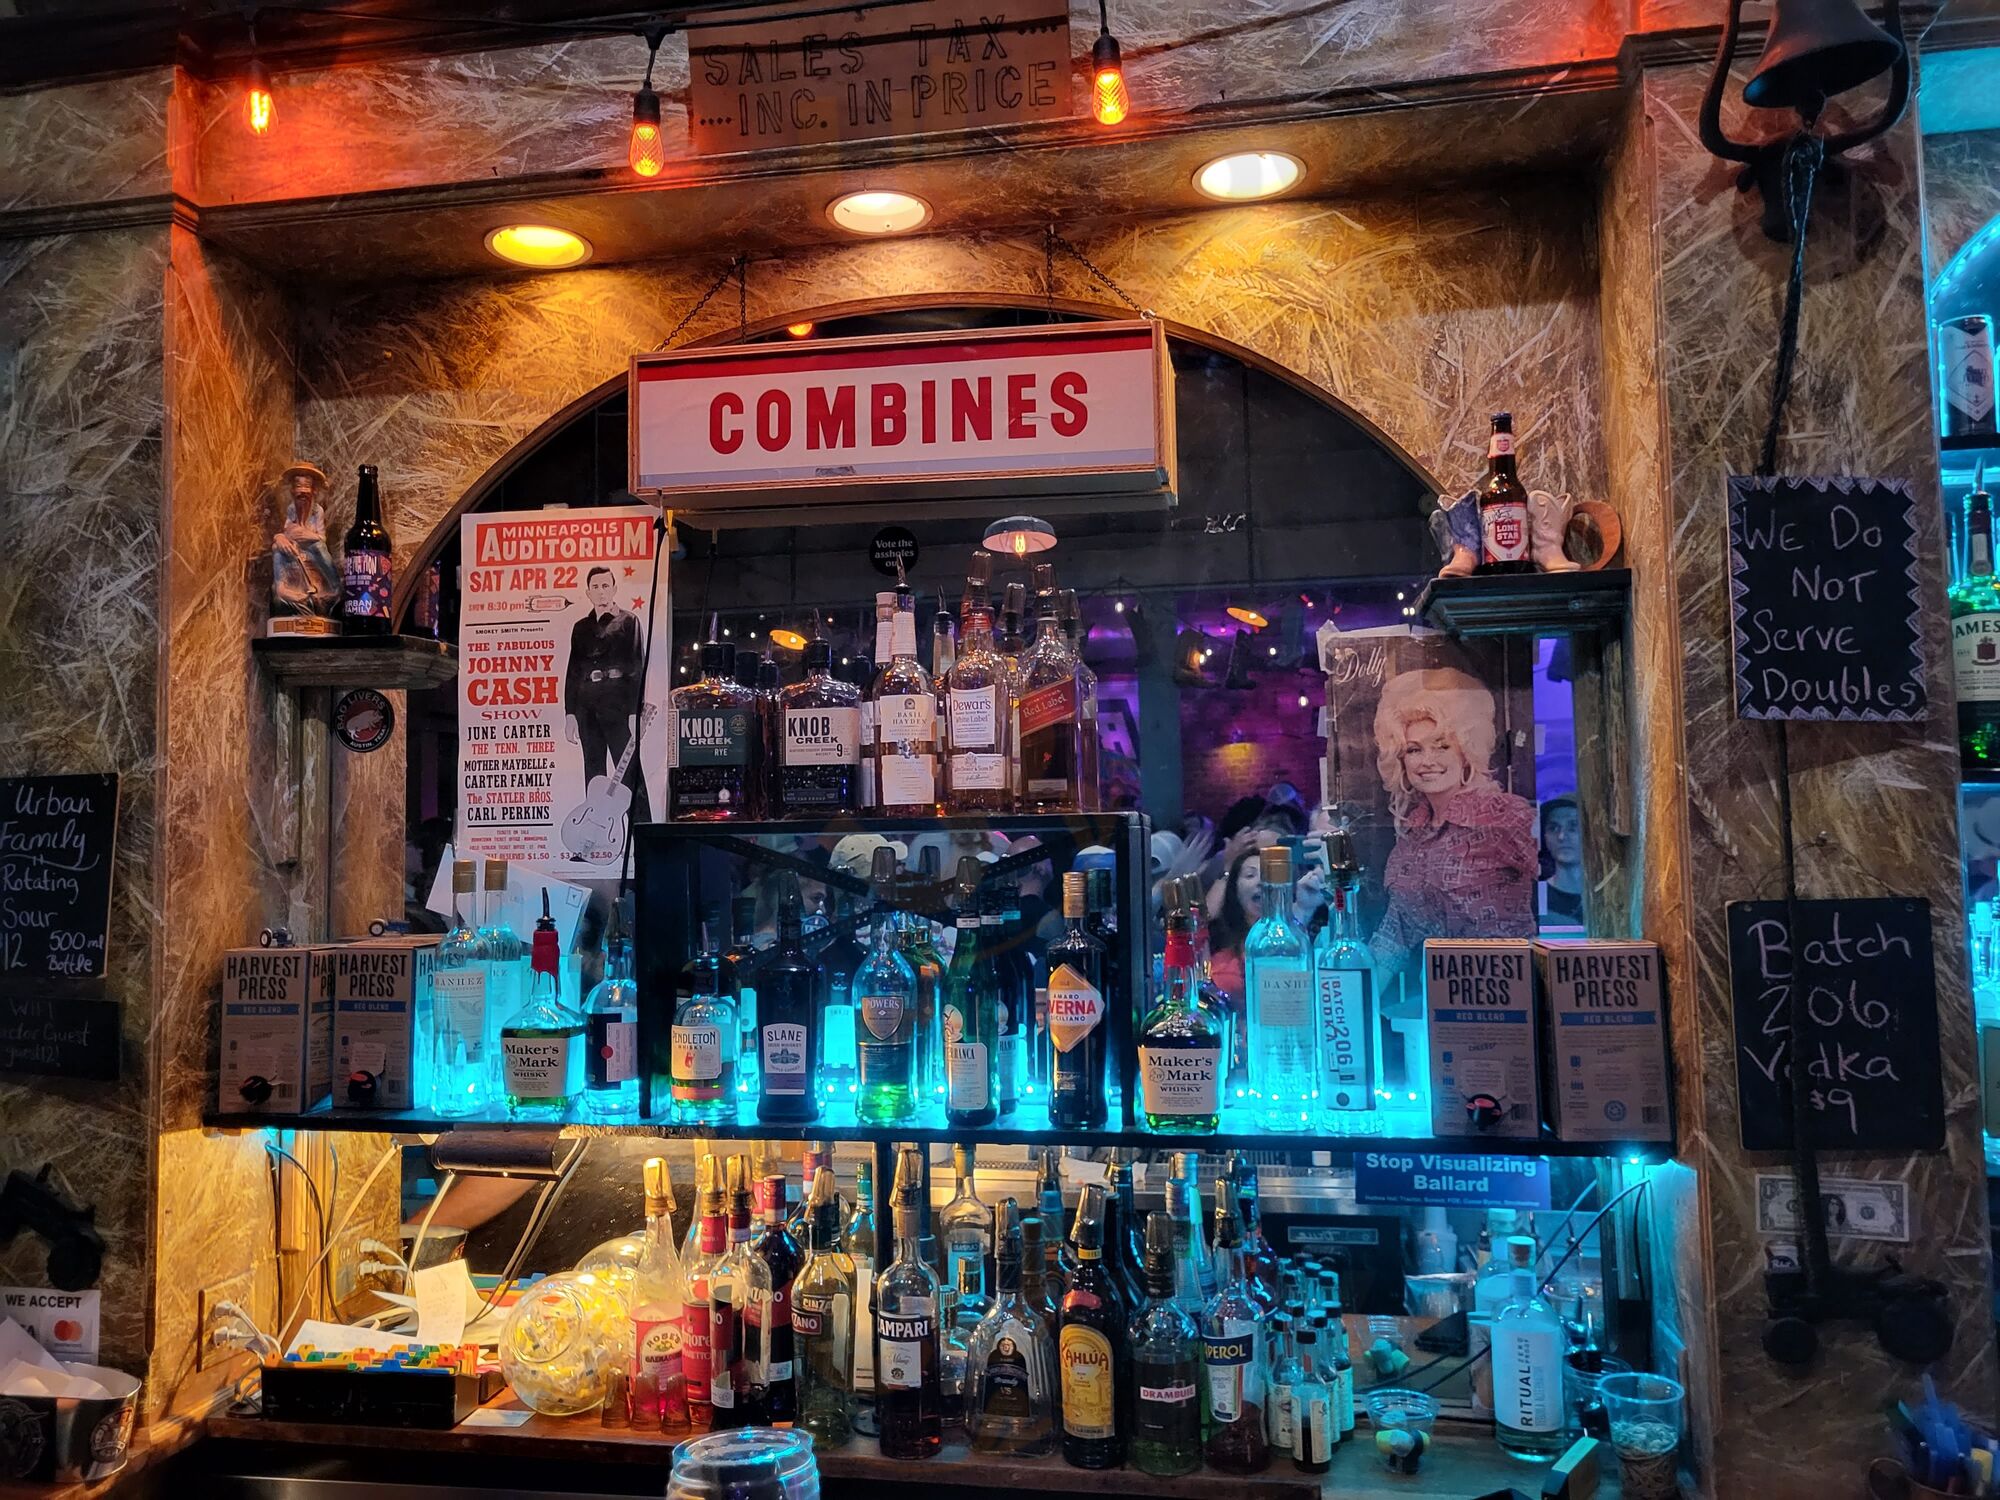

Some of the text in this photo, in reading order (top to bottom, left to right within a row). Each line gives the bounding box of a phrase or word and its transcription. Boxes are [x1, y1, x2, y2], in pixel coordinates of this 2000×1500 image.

[704, 31, 864, 87] SALES
[910, 60, 1056, 119] PRICE
[709, 371, 1088, 455] COMBINES
[502, 521, 618, 538] MINNEAPOLIS
[1496, 524, 1518, 533] LONE
[1496, 532, 1519, 541] STAR
[481, 521, 647, 563] AUDITORIUM
[875, 539, 913, 549] Vote the
[874, 549, 915, 559] assholes
[469, 566, 578, 593] SAT APR 22
[487, 601, 508, 612] 8:30
[509, 602, 525, 613] pm
[468, 640, 555, 652] THE FABULOUS
[468, 655, 555, 674] JOHNNY
[1335, 645, 1387, 688] Dolly
[467, 677, 559, 706] CASH
[1762, 665, 1918, 708] Doubles
[346, 690, 387, 711] LIVERS
[953, 698, 992, 712] Dewar's
[1022, 703, 1042, 718] Red
[1041, 693, 1068, 713] Label
[481, 709, 543, 721] SHOW
[970, 714, 989, 723] Label
[467, 724, 551, 742] JUNE CARTER
[681, 717, 725, 738] KNOB
[788, 716, 830, 737] KNOB
[472, 741, 555, 755] THE TENN. THREE
[688, 736, 733, 745] CREEK
[796, 736, 838, 744] CREEK
[836, 743, 843, 757] 9
[714, 748, 728, 757] RYE
[464, 758, 555, 772] MOTHER MAYBELLE &
[465, 773, 552, 789] CARTER FAMILY
[14, 783, 96, 816] Urban
[467, 791, 554, 804] The STATLER BROS.
[468, 806, 550, 821] CARL PERKINS
[0, 817, 87, 867] Family
[527, 852, 550, 861] $1.50
[590, 850, 613, 859] $2.50
[2, 862, 80, 906] Rotating
[2, 896, 59, 929] Sour
[1747, 912, 1913, 980] Batch
[47, 953, 94, 974] Bottle
[227, 956, 302, 979] HARVEST
[339, 954, 408, 976] HARVEST
[1431, 954, 1524, 981] HARVEST
[1556, 954, 1651, 984] HARVEST
[238, 977, 287, 999] PRESS
[350, 975, 395, 997] PRESS
[1449, 978, 1511, 1005] PRESS
[1574, 980, 1639, 1008] PRESS
[1320, 980, 1338, 1043] VODKA
[1758, 979, 1891, 1035] 206
[1331, 980, 1354, 1066] BATCH 206
[767, 1030, 803, 1042] SLANE
[505, 1044, 559, 1056] Maker's
[519, 1057, 559, 1068] Mark
[1148, 1055, 1213, 1068] Maker's
[1743, 1040, 1900, 1083] Vdka
[1167, 1069, 1213, 1081] Mark
[1160, 1085, 1203, 1093] WHISKY
[1365, 1152, 1538, 1177] Stop Visualizing
[1413, 1174, 1490, 1193] Ballard
[5, 1294, 83, 1309] WE ACCEPT
[878, 1317, 929, 1339] AMPARI
[1142, 1386, 1195, 1400] DRAMBUIE
[1518, 1364, 1534, 1428] RITUAL
